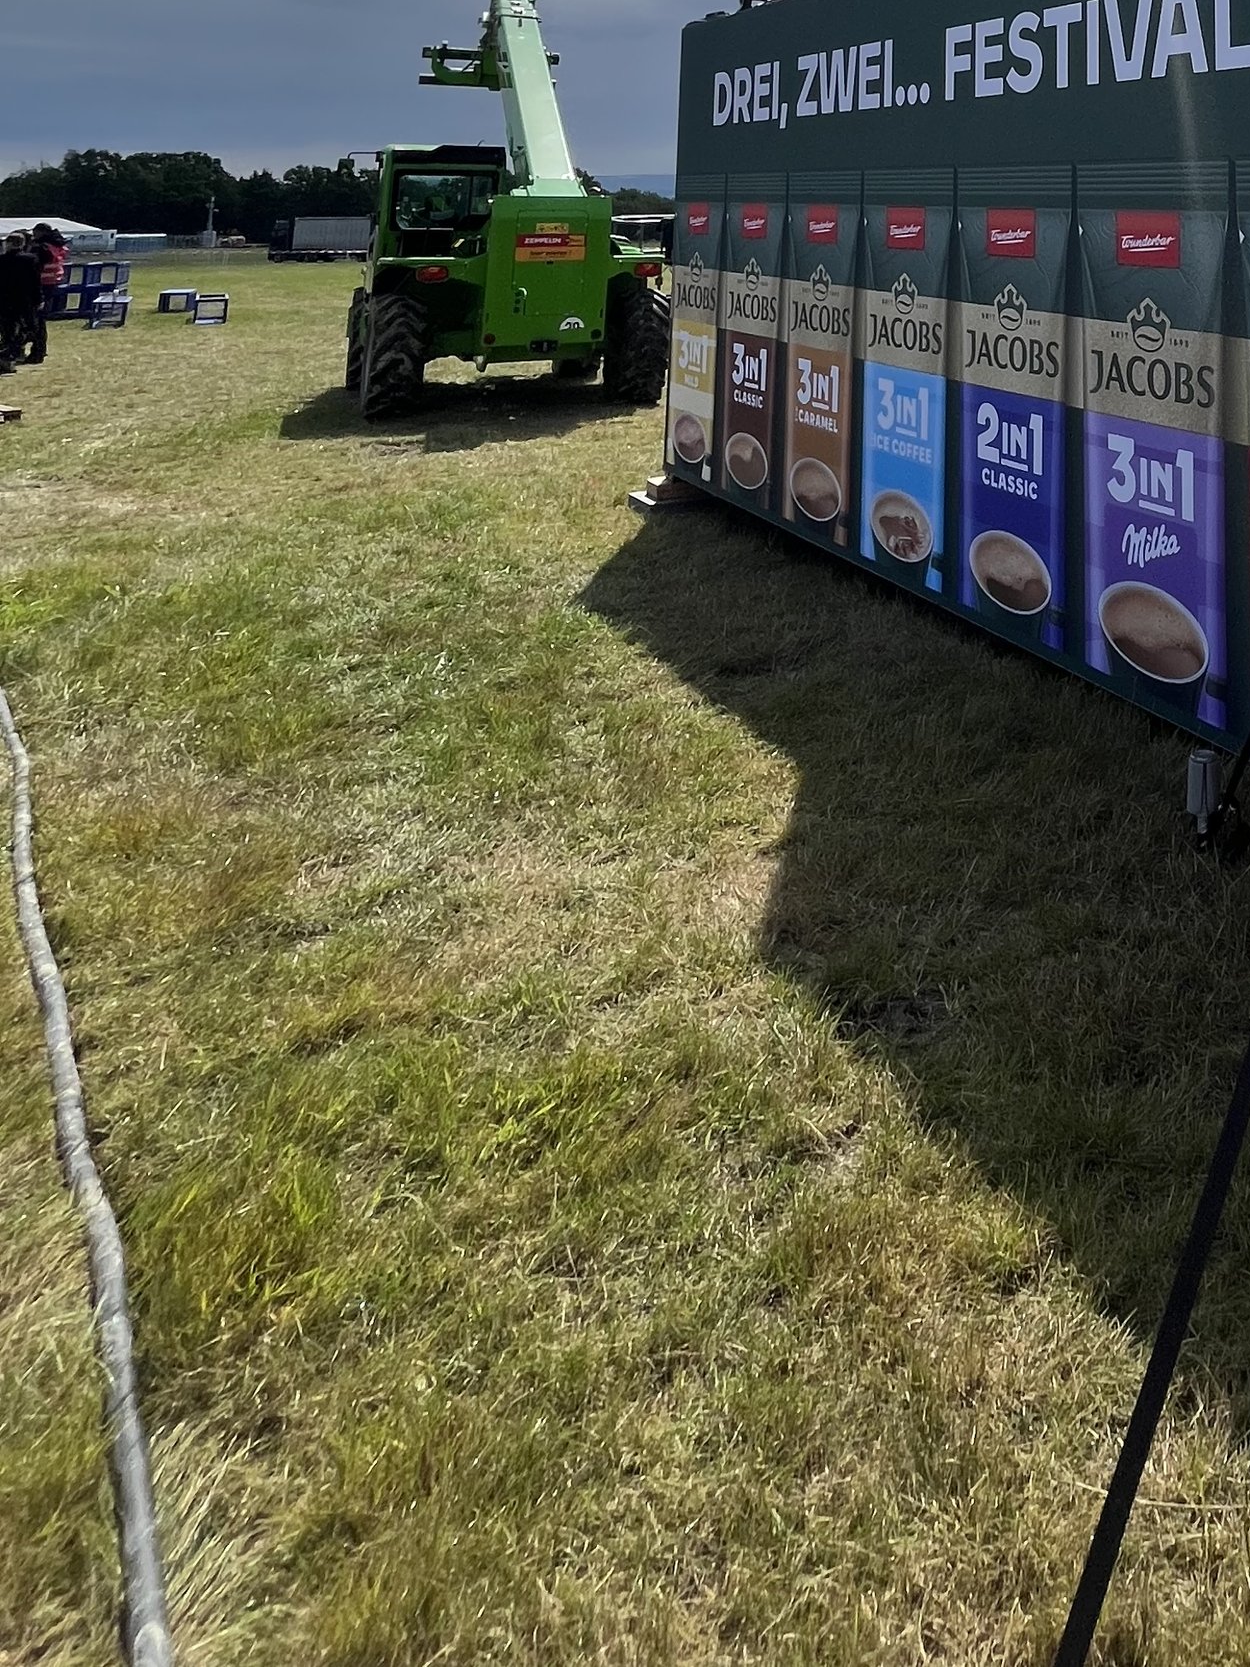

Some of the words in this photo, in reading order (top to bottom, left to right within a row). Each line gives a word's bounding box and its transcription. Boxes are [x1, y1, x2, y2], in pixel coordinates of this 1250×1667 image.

[713, 59, 788, 129] DREI,
[795, 38, 931, 117] ZWEI...
[675, 283, 716, 312] JACOBS
[727, 291, 777, 323] JACOBS
[790, 299, 850, 337] JACOBS
[868, 313, 943, 355] JACOBS
[965, 329, 1060, 377] JACOBS
[1089, 349, 1215, 408] JACOBS
[733, 389, 764, 409] CLASSIC
[798, 408, 838, 433] CARAMEL
[891, 439, 933, 464] COFFEE
[981, 467, 1039, 500] CLASSIC
[1121, 523, 1181, 568] Milka
